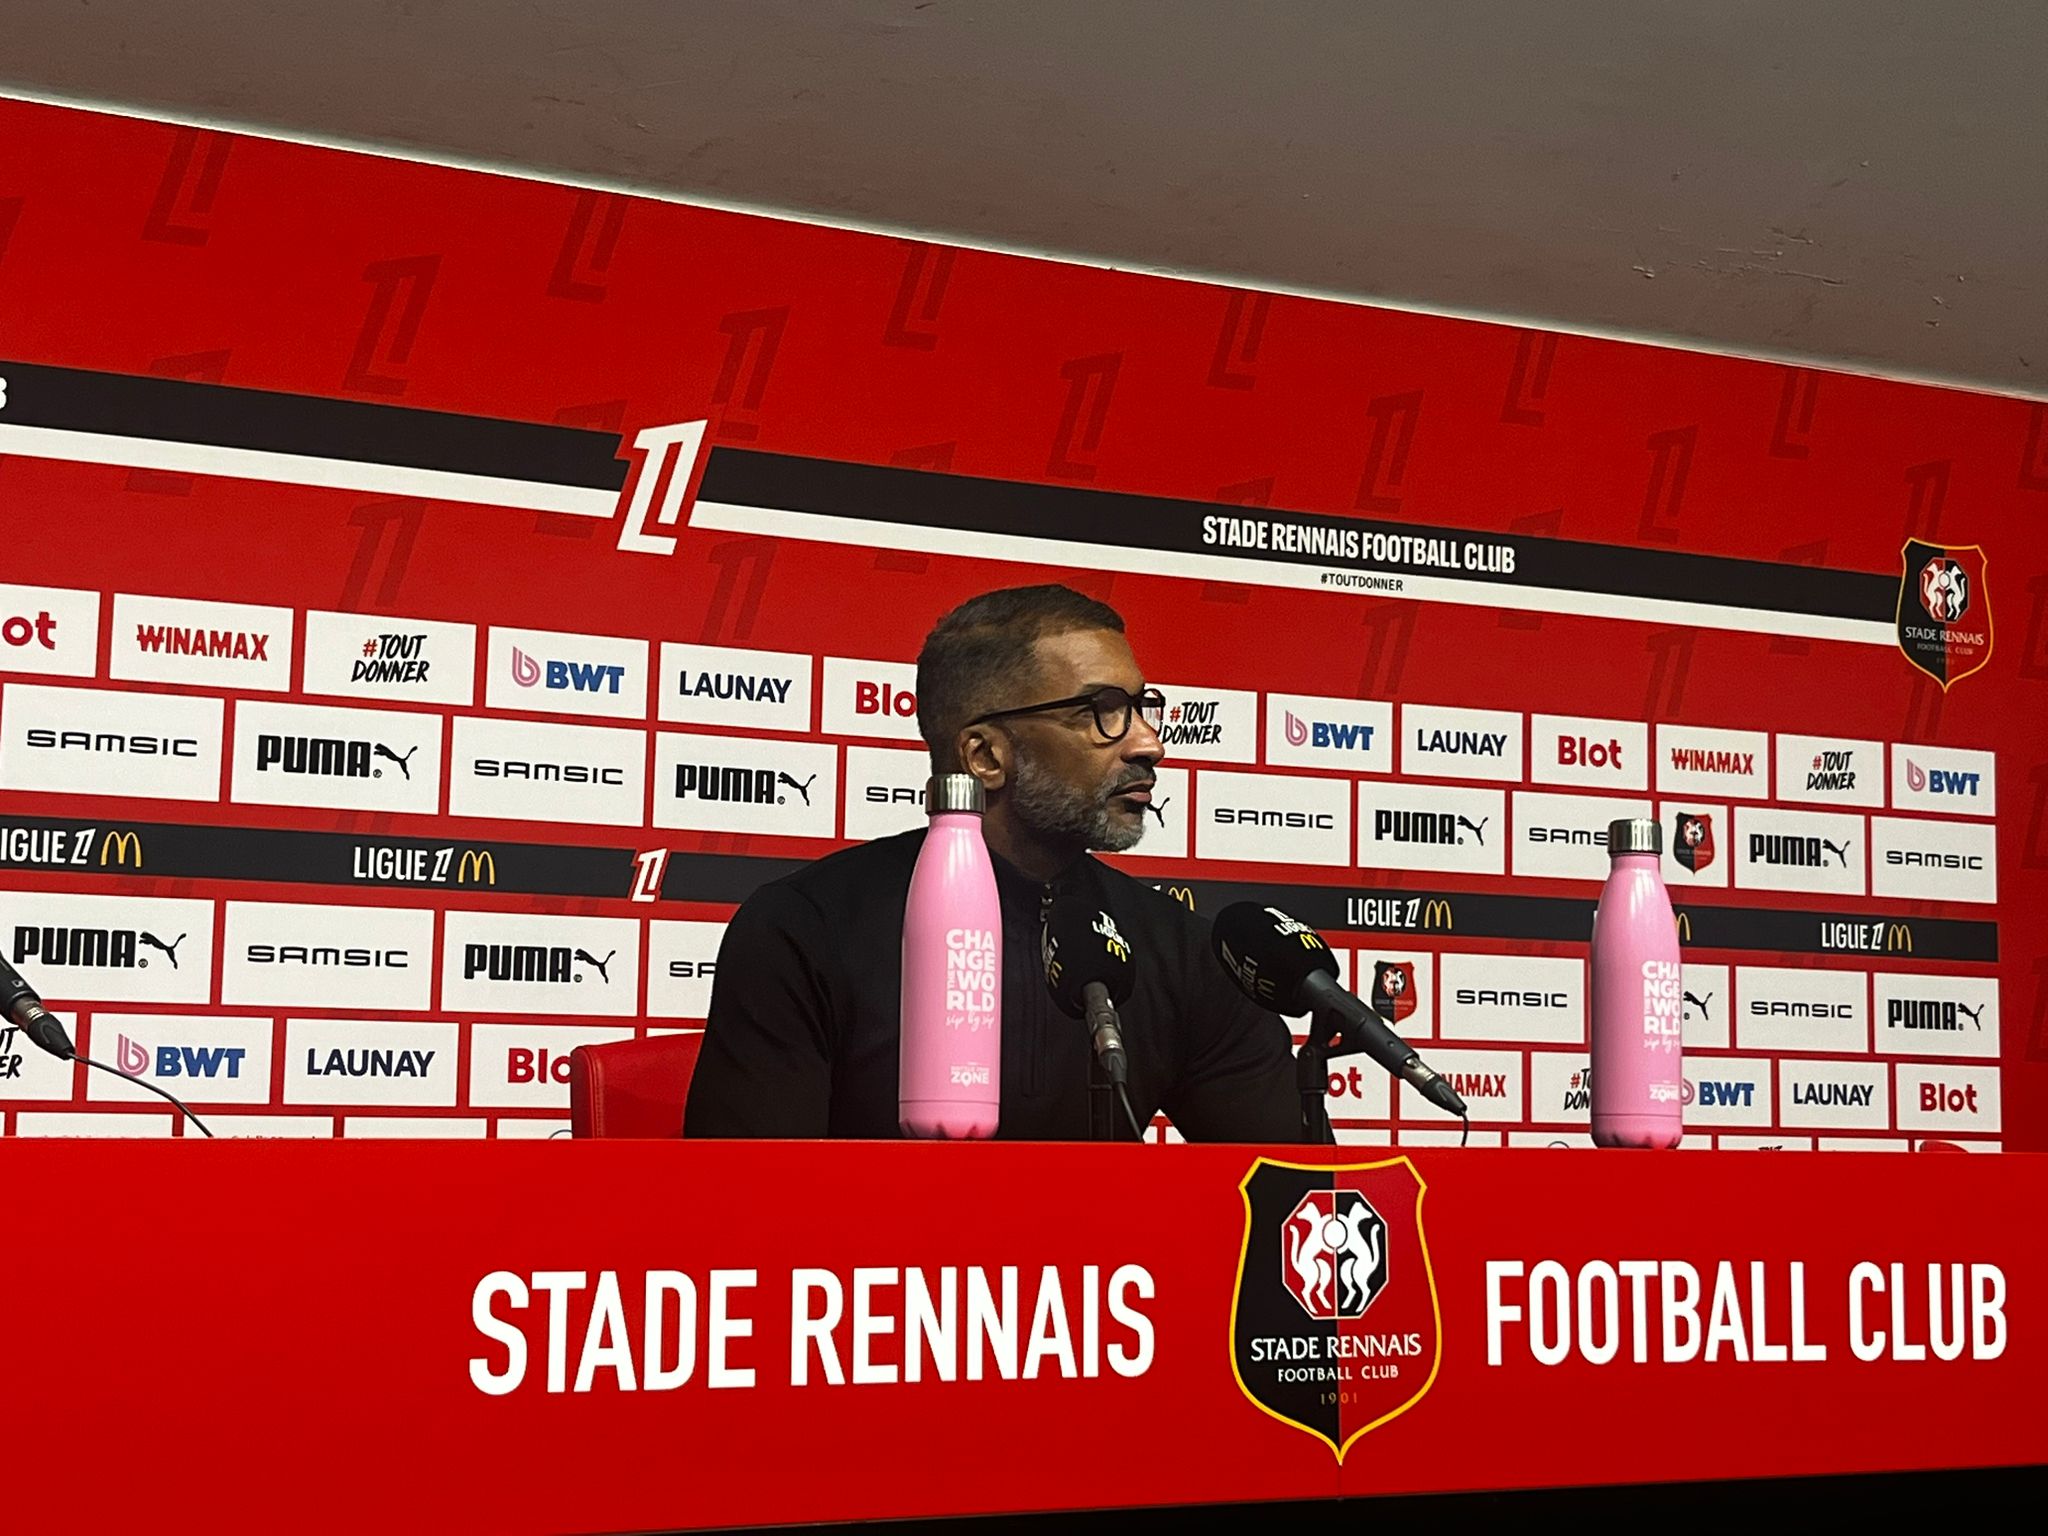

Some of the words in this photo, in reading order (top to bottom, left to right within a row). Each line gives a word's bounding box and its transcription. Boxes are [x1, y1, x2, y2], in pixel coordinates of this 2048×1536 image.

[1202, 515, 1267, 550] STADE
[1271, 522, 1359, 559] RENNAIS
[1362, 532, 1461, 569] FOOTBALL
[1464, 542, 1515, 574] CLUB
[1320, 572, 1403, 591] #TOUTDONNER
[1, 611, 57, 651] ot
[136, 624, 270, 662] WINAMAX
[1905, 626, 1937, 640] STADE
[1939, 630, 1985, 646] RENNAIS
[362, 634, 428, 659] #TOUT
[351, 660, 430, 683] DONNER
[546, 660, 625, 694] BWT
[679, 670, 793, 704] LAUNAY
[856, 681, 917, 717] Blo
[1170, 701, 1220, 724] #TOUT
[27, 729, 198, 757] SAMSIC
[1162, 724, 1222, 745] DONNER
[1312, 722, 1374, 751] BWT
[1418, 728, 1508, 757] LAUNAY
[257, 734, 370, 778] PUMA
[1557, 735, 1622, 770] Blot
[1671, 748, 1754, 775] WINAMAX
[1812, 751, 1854, 771] #TOUT
[474, 759, 624, 786] SAMSIC
[675, 763, 775, 804] PUMA
[1806, 771, 1856, 790] DONNER
[1929, 769, 1980, 796] BWT
[1215, 808, 1334, 830] SAMSIC
[1375, 809, 1455, 845] PUMA
[1, 828, 67, 863] IGUE
[1529, 827, 1608, 845] SAMS
[354, 846, 427, 881] LIGUE
[1750, 834, 1821, 867] PUMA
[1887, 851, 1983, 870] SAMSIC
[1348, 898, 1402, 927] LIGUE
[13, 926, 136, 968] PUMA
[945, 928, 995, 951] CHA
[1821, 922, 1868, 949] LIGUE
[247, 944, 409, 968] SAMSIC
[464, 944, 572, 983] PUMA
[947, 949, 995, 971] NGE
[1456, 989, 1568, 1008] SAMSIC
[1751, 1000, 1853, 1019] SAMSIC
[1887, 998, 1957, 1031] PUMA
[155, 1046, 246, 1079] BWT
[307, 1047, 436, 1078] LAUNAY
[507, 1047, 571, 1084] Blo
[950, 1070, 990, 1087] ZONE
[1329, 1066, 1363, 1099] ot
[1699, 1081, 1755, 1107] BWT
[1793, 1083, 1875, 1107] LAUNAY
[1919, 1083, 1978, 1114] Blot
[1486, 1260, 1827, 1366] FOOTBALL
[1849, 1261, 2007, 1362] CLUB
[469, 1269, 758, 1396] STADE
[791, 1264, 1155, 1386] RENNAIS
[1250, 1337, 1320, 1361] STADE
[1327, 1333, 1422, 1359] RENNAIS
[1278, 1367, 1353, 1383] FOOTBALL
[1361, 1365, 1399, 1380] CLUB
[1320, 1392, 1358, 1405] 1901
